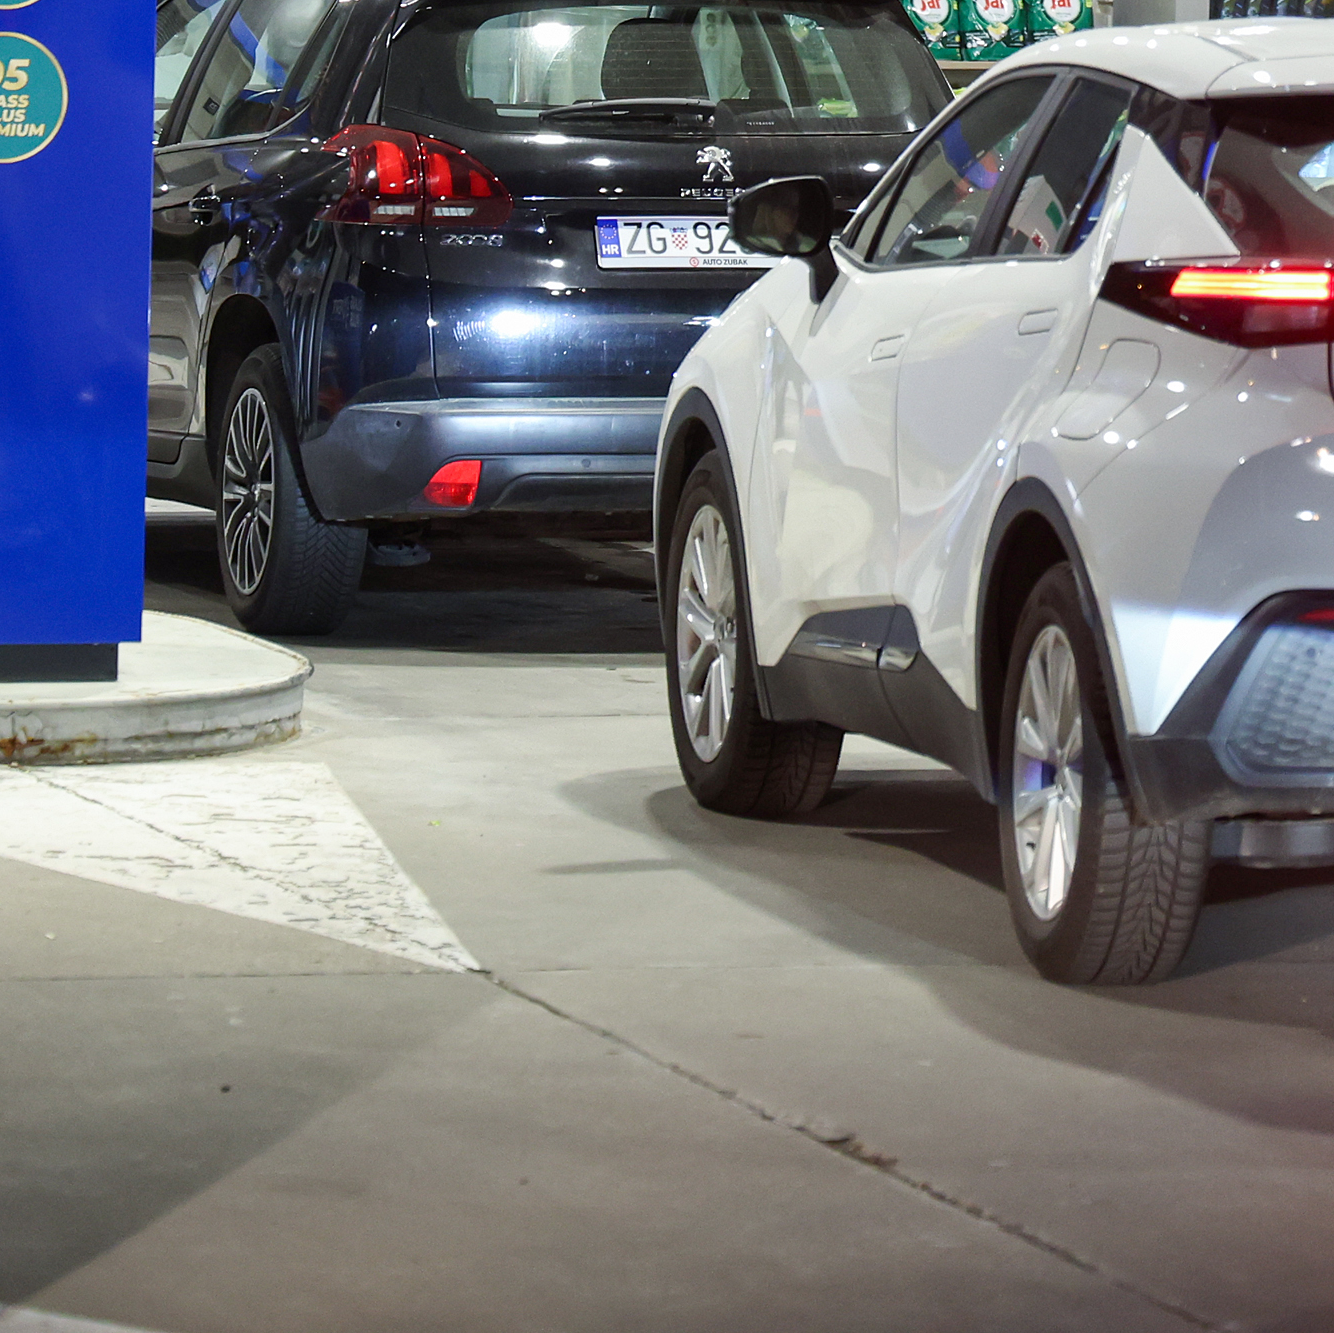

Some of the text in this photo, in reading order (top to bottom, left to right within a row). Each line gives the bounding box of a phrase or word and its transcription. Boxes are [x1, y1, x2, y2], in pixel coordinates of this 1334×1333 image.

[602, 221, 755, 255] HR ZG 92
[702, 257, 749, 266] AUTO ZUBAK
